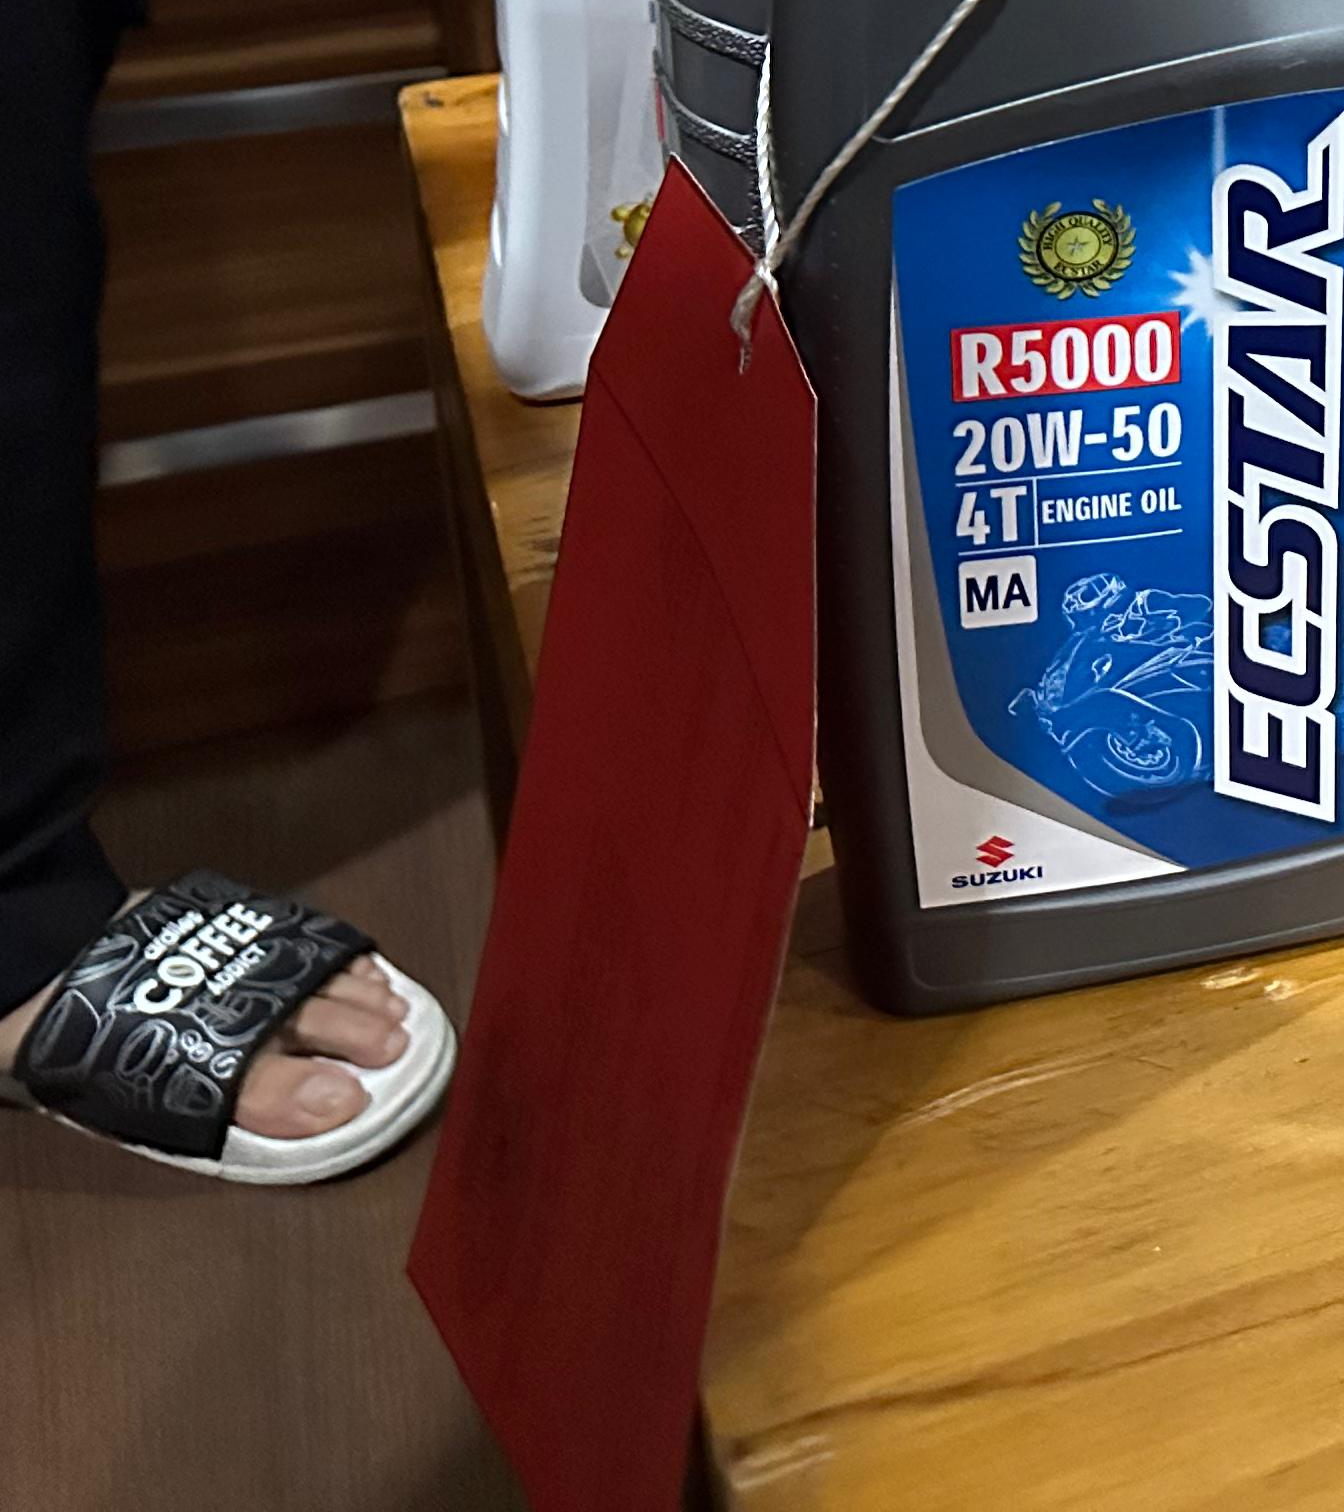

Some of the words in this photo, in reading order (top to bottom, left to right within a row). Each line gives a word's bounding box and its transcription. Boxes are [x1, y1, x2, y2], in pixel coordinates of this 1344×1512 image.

[1068, 216, 1114, 247] QUALITY
[960, 319, 1173, 399] R5000
[952, 402, 1182, 477] 20W-50
[955, 485, 1028, 546] 4T
[1041, 491, 1133, 525] ENGINE
[1140, 486, 1182, 514] OIL
[965, 572, 1032, 613] MA
[951, 866, 1044, 890] SUZUKI
[132, 902, 275, 1014] COFFEE
